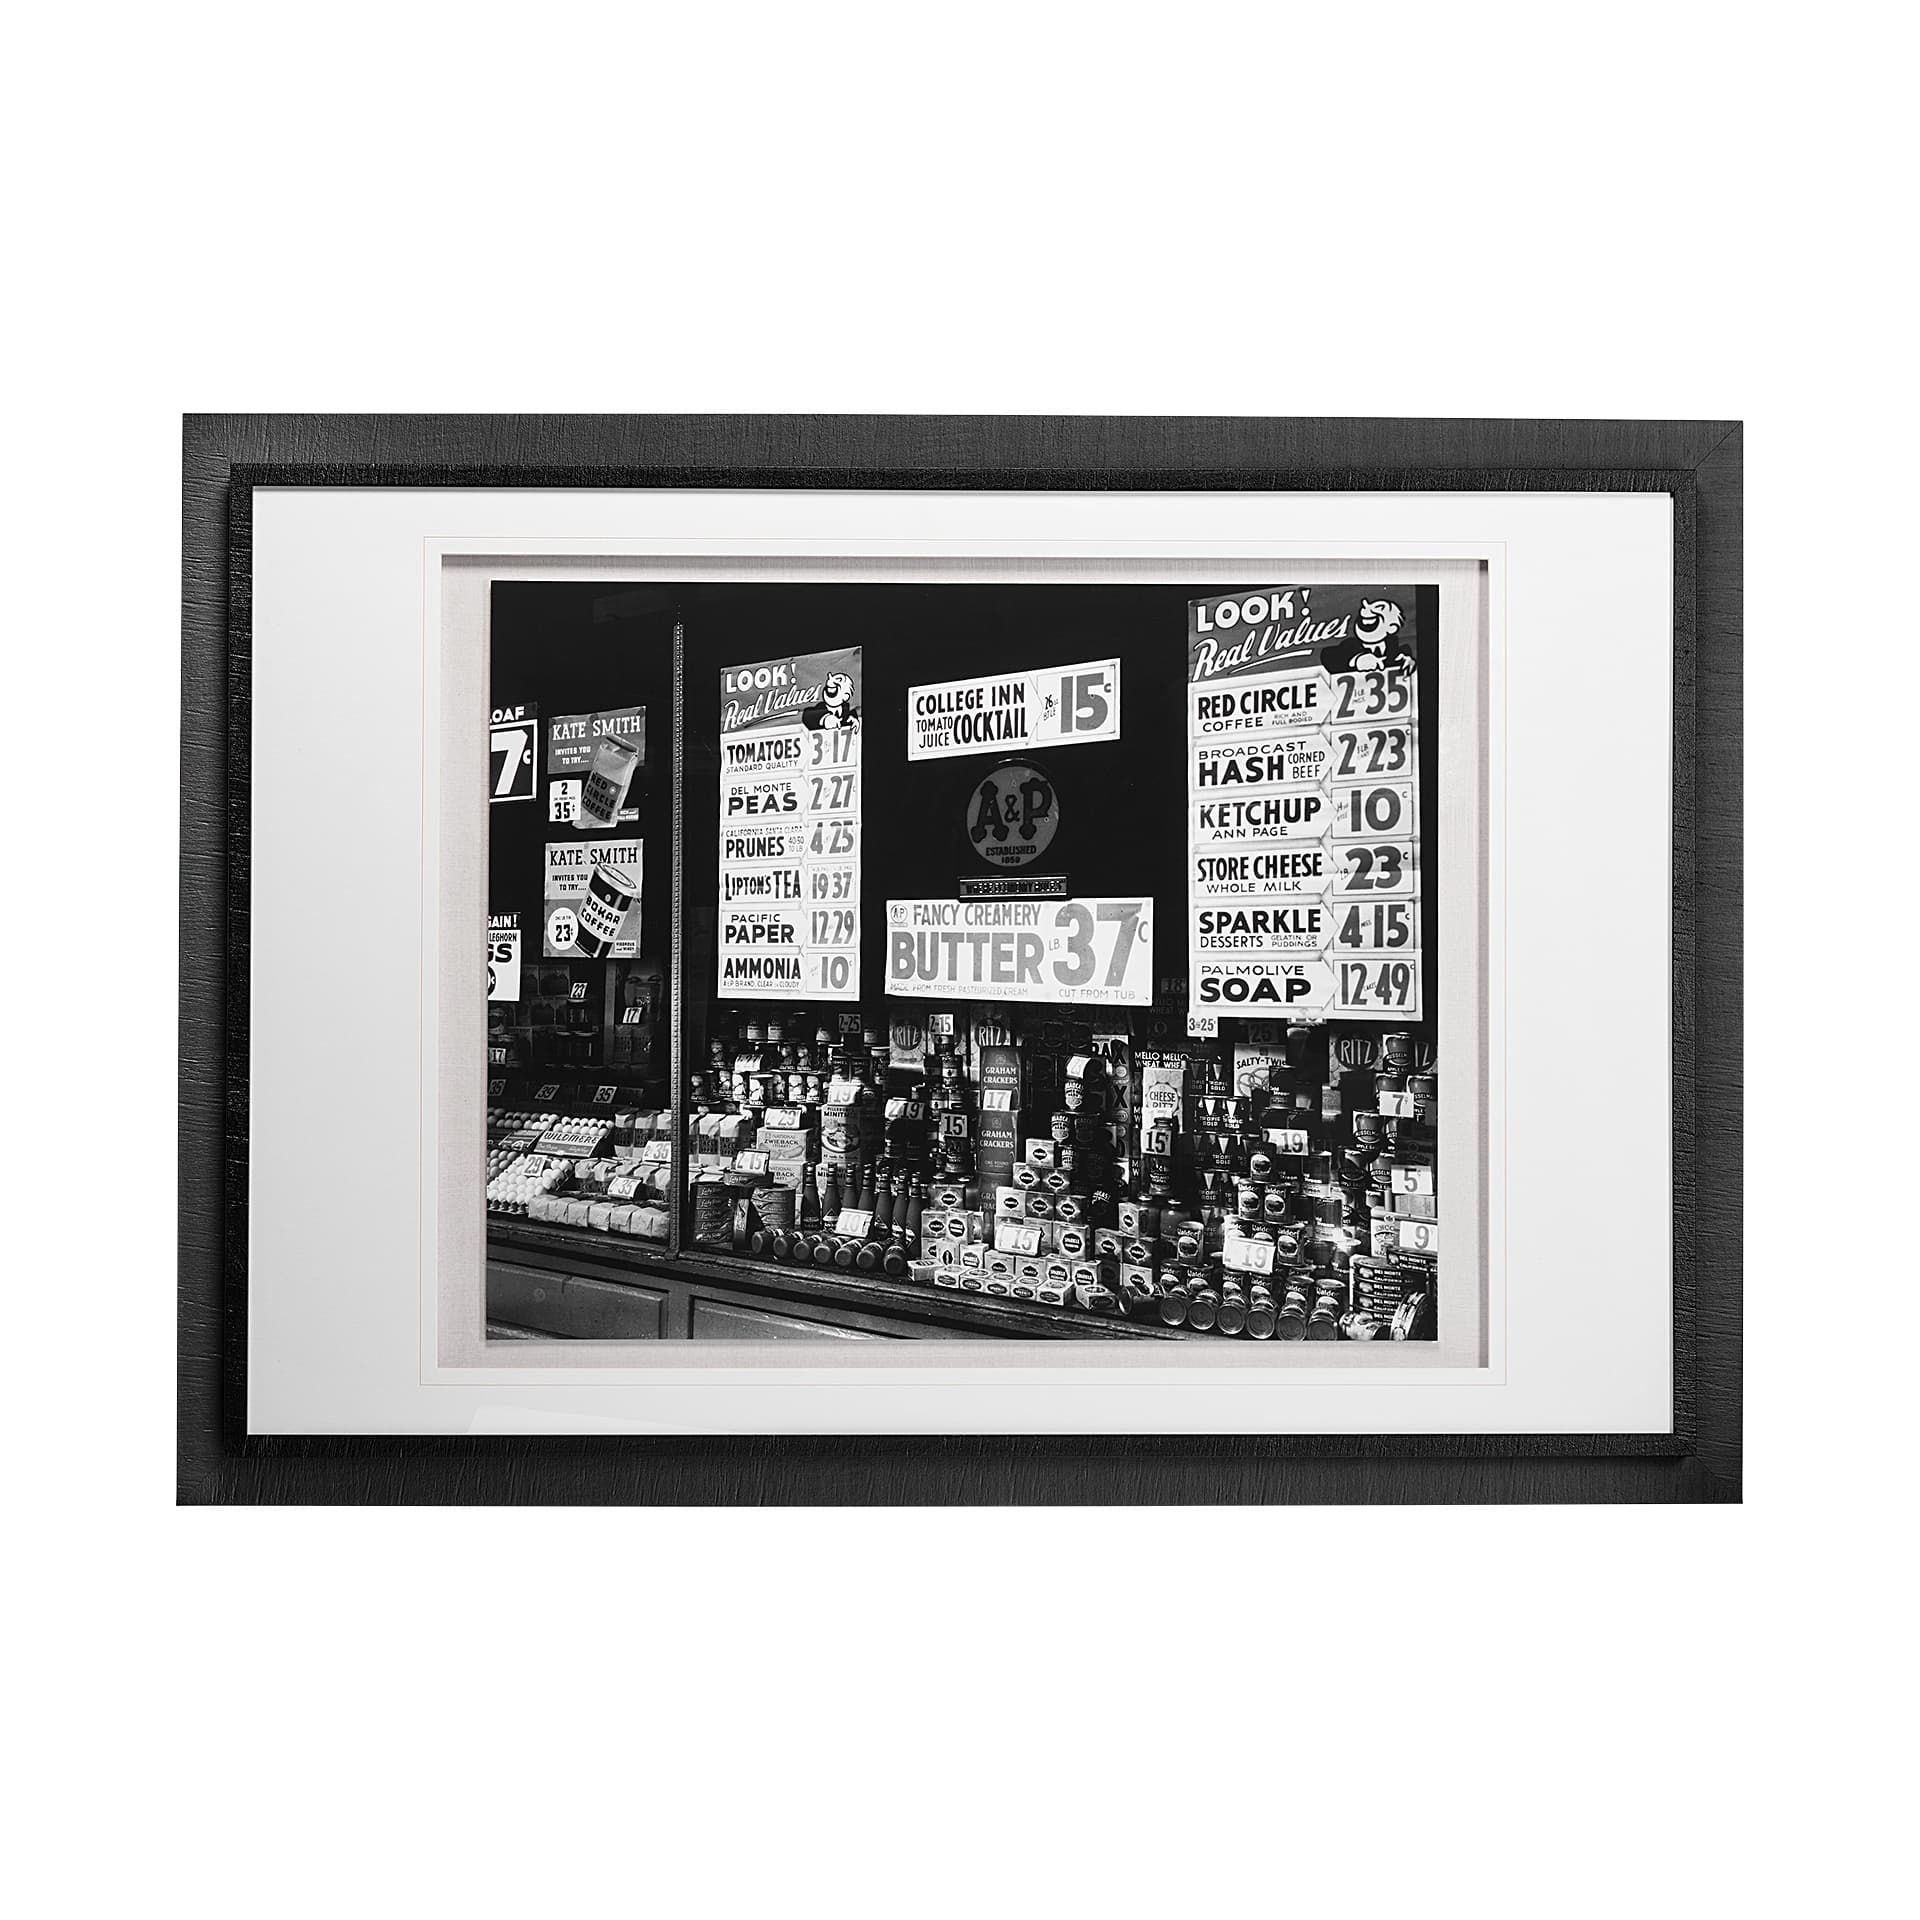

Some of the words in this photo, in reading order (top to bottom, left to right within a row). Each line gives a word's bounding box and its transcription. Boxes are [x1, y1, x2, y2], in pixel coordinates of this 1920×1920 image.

[1197, 589, 1311, 632] LOOK!
[1192, 638, 1256, 682] Real
[1258, 615, 1351, 656] Values
[726, 663, 797, 693] LOOK!
[723, 694, 763, 732] Real
[765, 683, 822, 714] Values
[916, 688, 984, 716] COLLEGE
[992, 682, 1025, 707] INN
[1198, 694, 1236, 720] RED
[1240, 683, 1317, 715] CIRCLE
[1336, 675, 1356, 719] 2
[552, 721, 586, 741] KATE
[592, 715, 641, 737] SMITH
[916, 716, 953, 733] TOMATO
[919, 731, 950, 748] JUICE
[953, 707, 1028, 744] COCKTAIL
[1203, 717, 1263, 732] COFFEE
[1289, 716, 1312, 724] BODIED
[555, 747, 577, 756] INVITES
[579, 746, 591, 754] YOU
[562, 757, 570, 765] TO
[726, 737, 801, 766] TOMATOES
[1199, 741, 1306, 760] BROADCAST
[1337, 733, 1357, 775] 2
[726, 762, 762, 774] STANDARD
[765, 759, 798, 770] QUALITY
[1199, 755, 1284, 787] HASH
[1288, 751, 1325, 764] CORNED
[1293, 765, 1320, 779] BEEF
[561, 782, 568, 795] 2
[591, 772, 608, 790] RED
[731, 786, 749, 796] DEL
[754, 783, 791, 793] MONTE
[586, 784, 617, 809] CIRCLE
[728, 792, 798, 816] PEAS
[810, 777, 823, 811] 2
[582, 797, 611, 820] COFFEE
[970, 777, 1053, 843] A&P
[1200, 797, 1321, 829] KETCHUP
[726, 828, 763, 838] CALIFORNIA
[810, 822, 824, 854] 4
[1212, 829, 1246, 840] ANN
[1253, 826, 1288, 837] PAGE
[550, 850, 583, 866] KATE
[590, 847, 638, 864] SMITH
[726, 836, 785, 859] PRUNES
[986, 845, 1036, 857] ESTABLISHED
[1198, 856, 1249, 881] STORE
[1253, 853, 1322, 880] CHEESE
[773, 870, 801, 899] TEA
[1207, 883, 1255, 893] WHOLE
[1264, 881, 1302, 892] MILK
[586, 895, 620, 924] BOKAR
[731, 914, 781, 923] PACIFIC
[914, 904, 960, 926] FANCY
[964, 904, 1042, 926] CREAMERY
[581, 908, 616, 937] COFFEE
[1200, 908, 1321, 934] SPARKLE
[1339, 905, 1363, 948] 4
[489, 932, 517, 942] LEGHORN
[725, 924, 795, 944] PAPER
[1049, 938, 1060, 951] LB
[1201, 936, 1264, 948] DESSERTS
[723, 957, 801, 980] AMMONIA
[891, 931, 1044, 985] BUTTER
[1202, 965, 1304, 976] PALMOLIVE
[912, 984, 931, 992] FROM
[1058, 989, 1076, 998] CUT
[1080, 990, 1109, 999] FROM
[1114, 990, 1135, 1000] TUB
[1200, 978, 1311, 1003] SOAP
[979, 1026, 1001, 1046] RITZ
[1135, 1051, 1160, 1060] MELLO
[1341, 1039, 1372, 1065] RITZ
[984, 1076, 1018, 1084] CRACKERS
[985, 1066, 1016, 1074] GRAHAM
[1149, 1091, 1176, 1102] CHEESE
[544, 1132, 598, 1144] WILDMERE
[980, 1139, 1014, 1148] CRACKERS
[1415, 1225, 1429, 1249] 9
